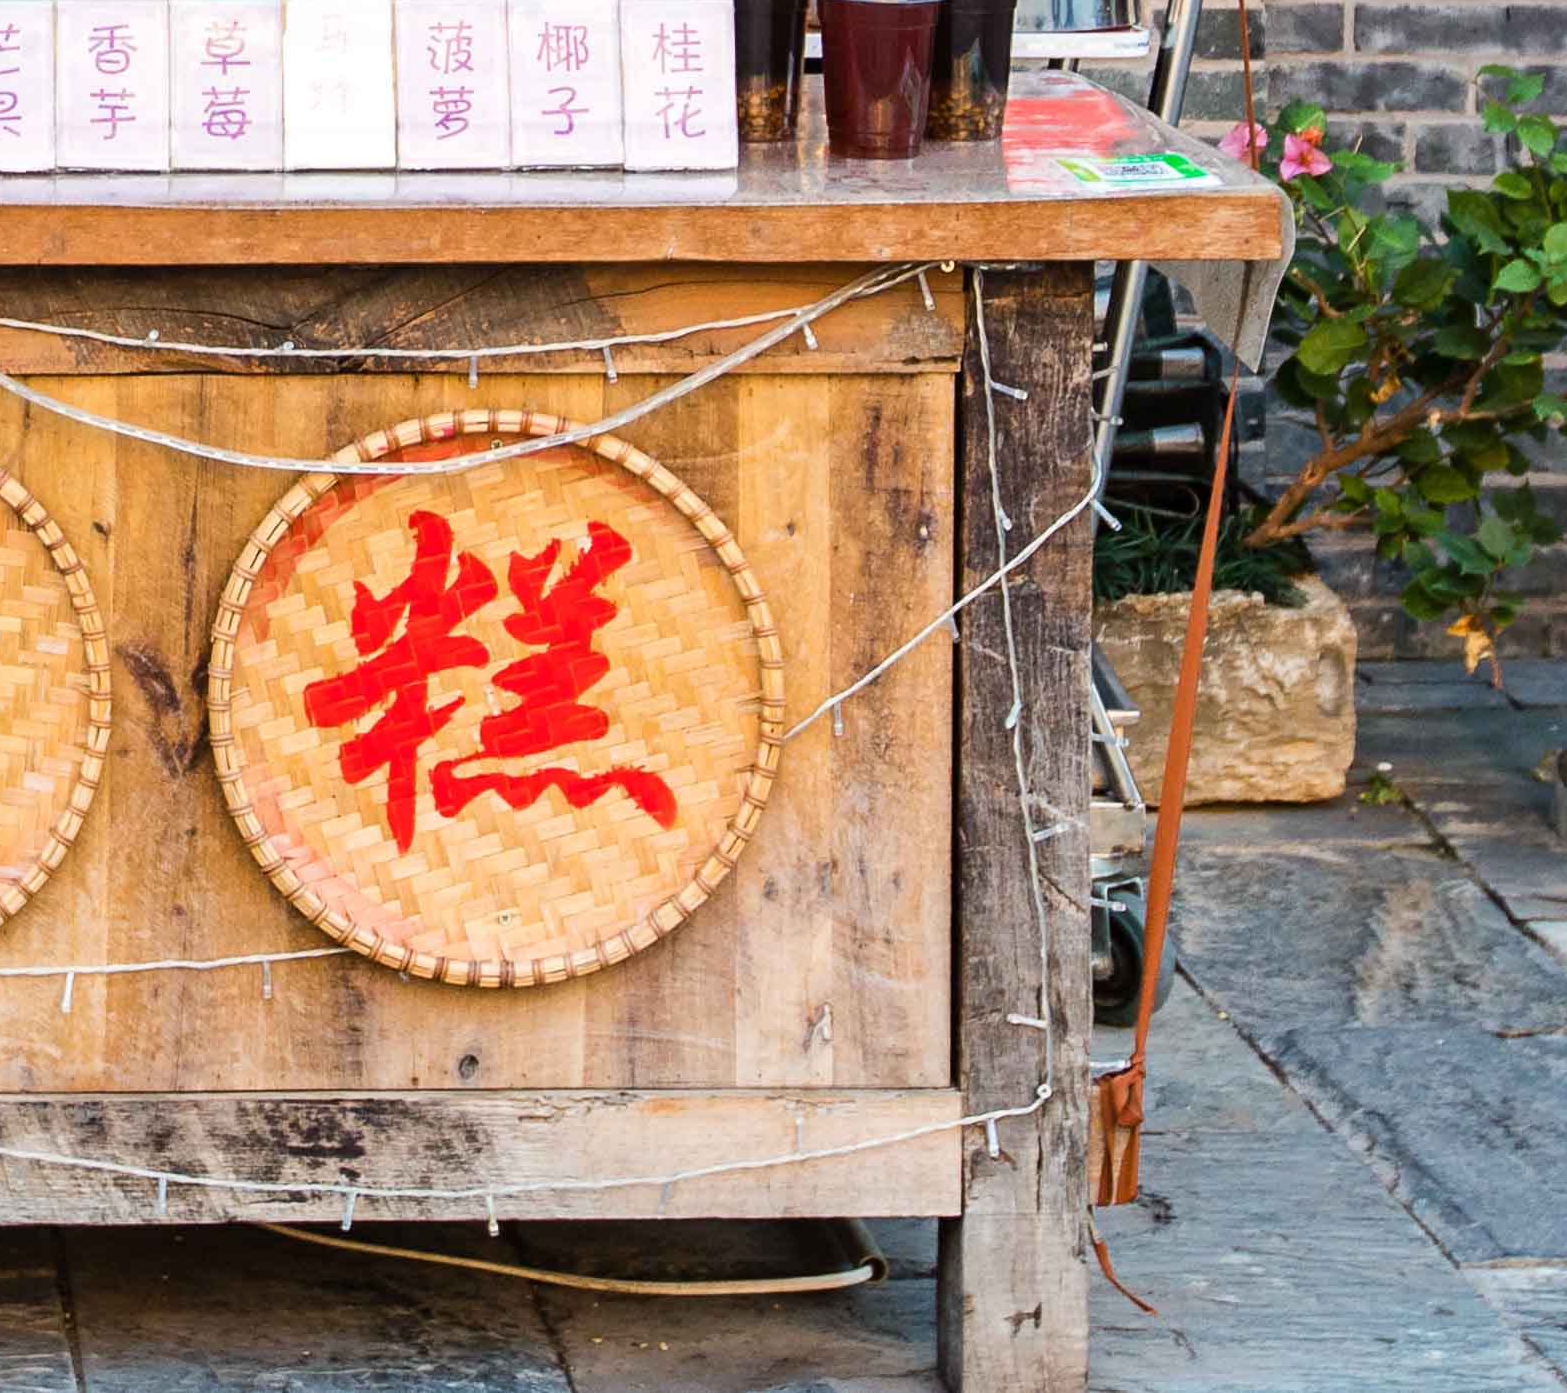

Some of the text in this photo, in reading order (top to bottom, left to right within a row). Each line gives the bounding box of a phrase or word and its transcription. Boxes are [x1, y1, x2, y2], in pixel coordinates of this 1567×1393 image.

[88, 24, 137, 140] 香芋
[201, 21, 252, 140] 草莓
[428, 21, 475, 140] 菠萝
[537, 22, 590, 136] 椰子
[652, 23, 707, 140] 桂花
